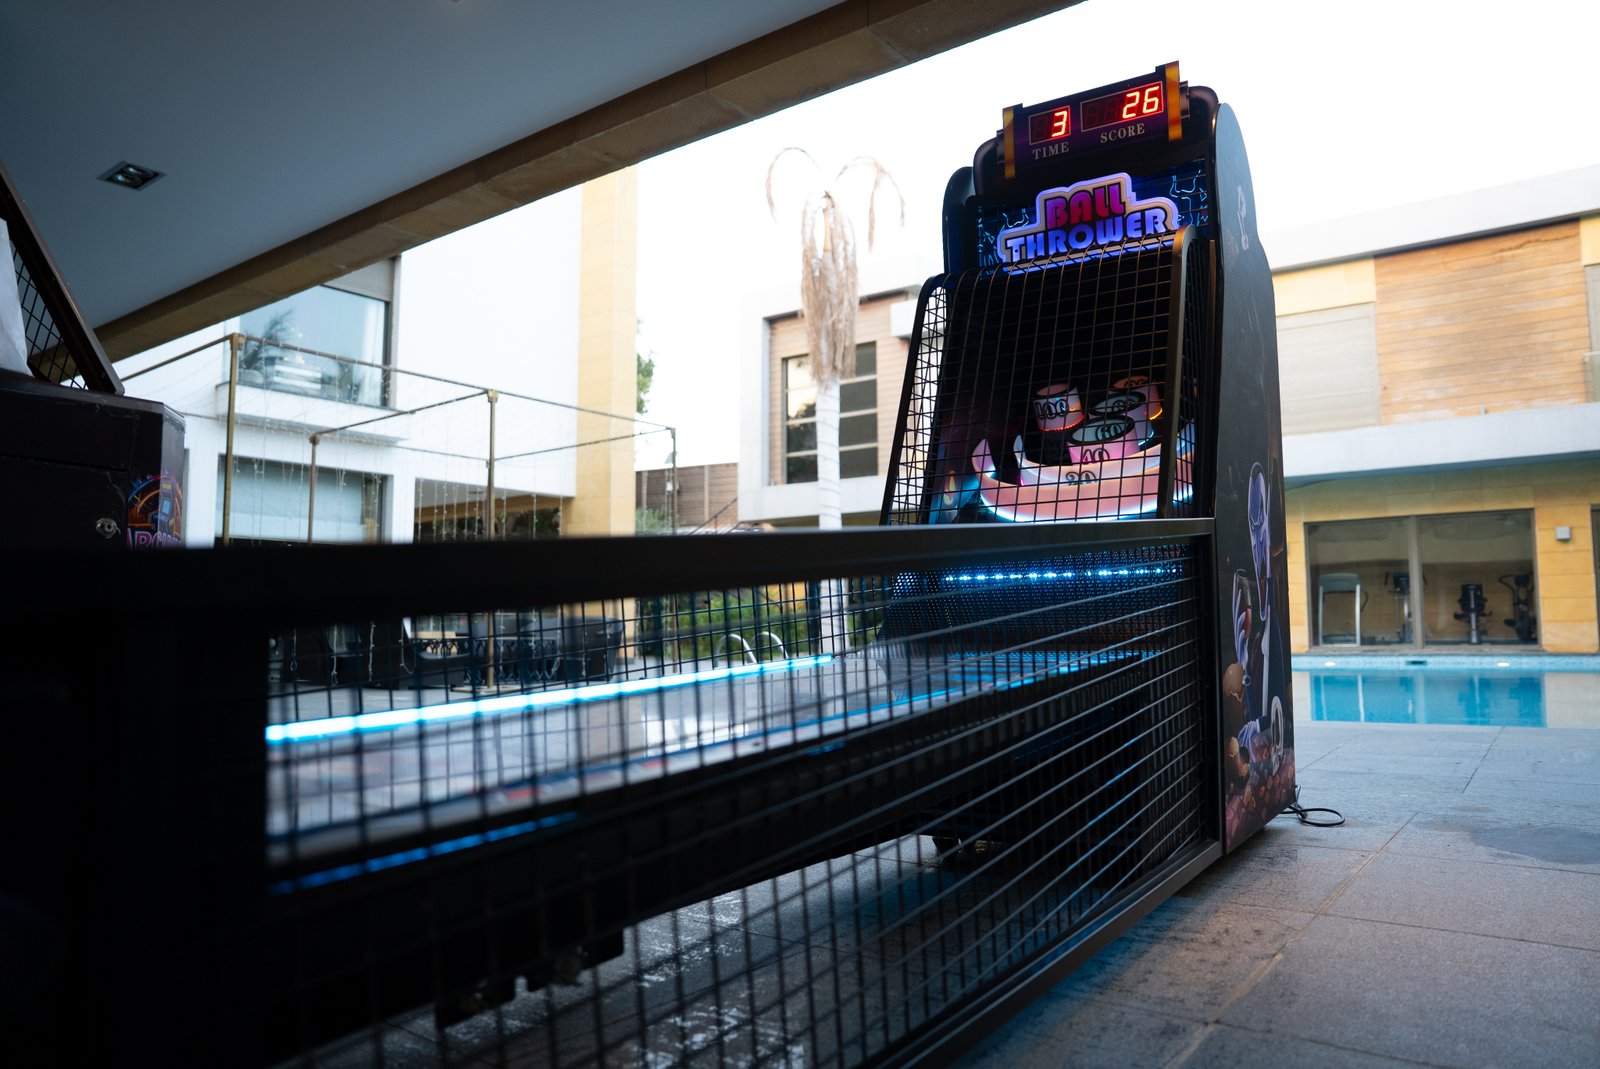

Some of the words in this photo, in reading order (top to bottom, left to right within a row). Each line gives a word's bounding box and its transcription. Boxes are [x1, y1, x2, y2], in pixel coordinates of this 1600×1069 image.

[1121, 86, 1160, 119] 26
[1051, 110, 1068, 137] 3
[1100, 123, 1145, 143] SCORE
[1032, 141, 1070, 160] TIME
[1045, 183, 1126, 229] BALL
[1006, 208, 1168, 263] THROWER
[1035, 400, 1069, 419] 100
[1096, 424, 1123, 441] 60
